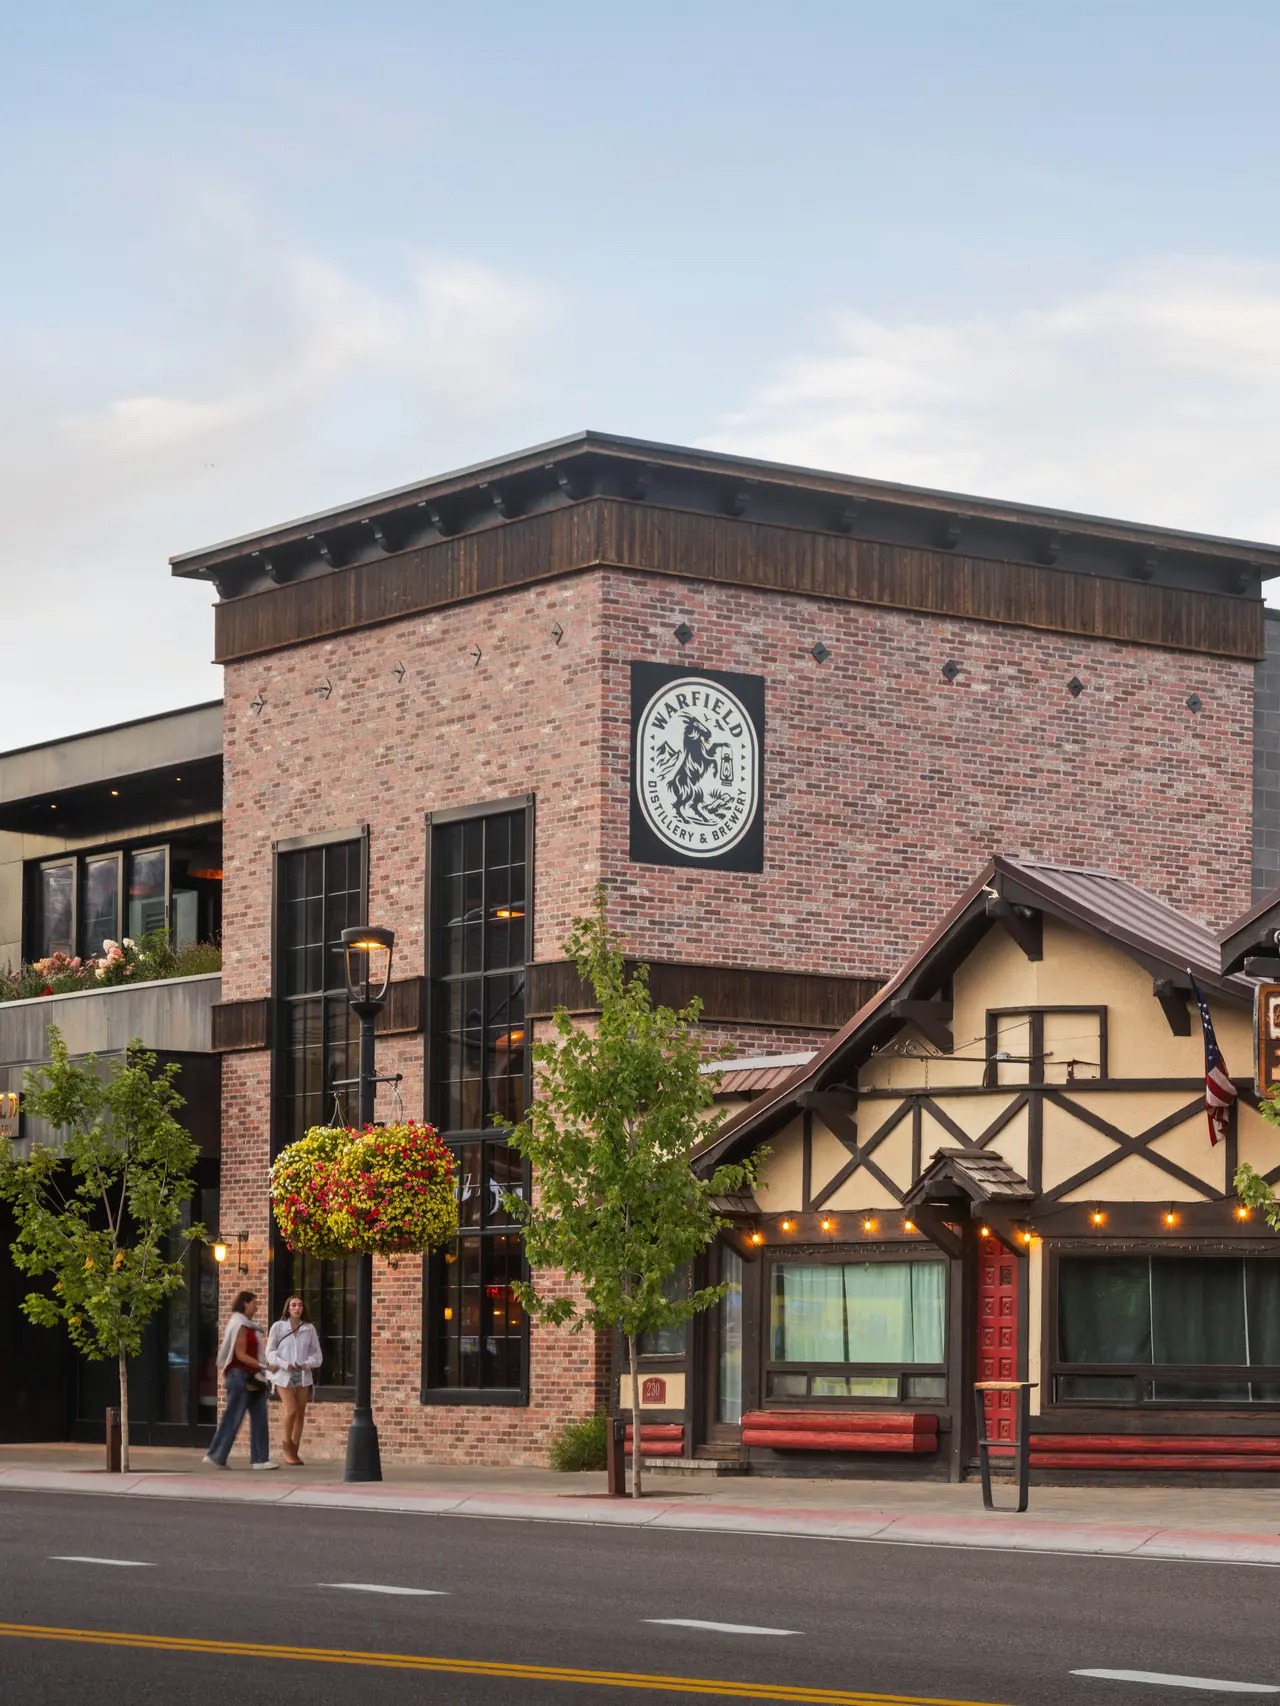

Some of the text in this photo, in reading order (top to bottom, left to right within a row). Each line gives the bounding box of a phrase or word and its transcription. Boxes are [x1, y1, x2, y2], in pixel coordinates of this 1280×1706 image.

[651, 690, 744, 739] WARFIELD
[648, 780, 747, 844] DISTILLERY & BREWERY
[647, 1383, 660, 1397] 230
